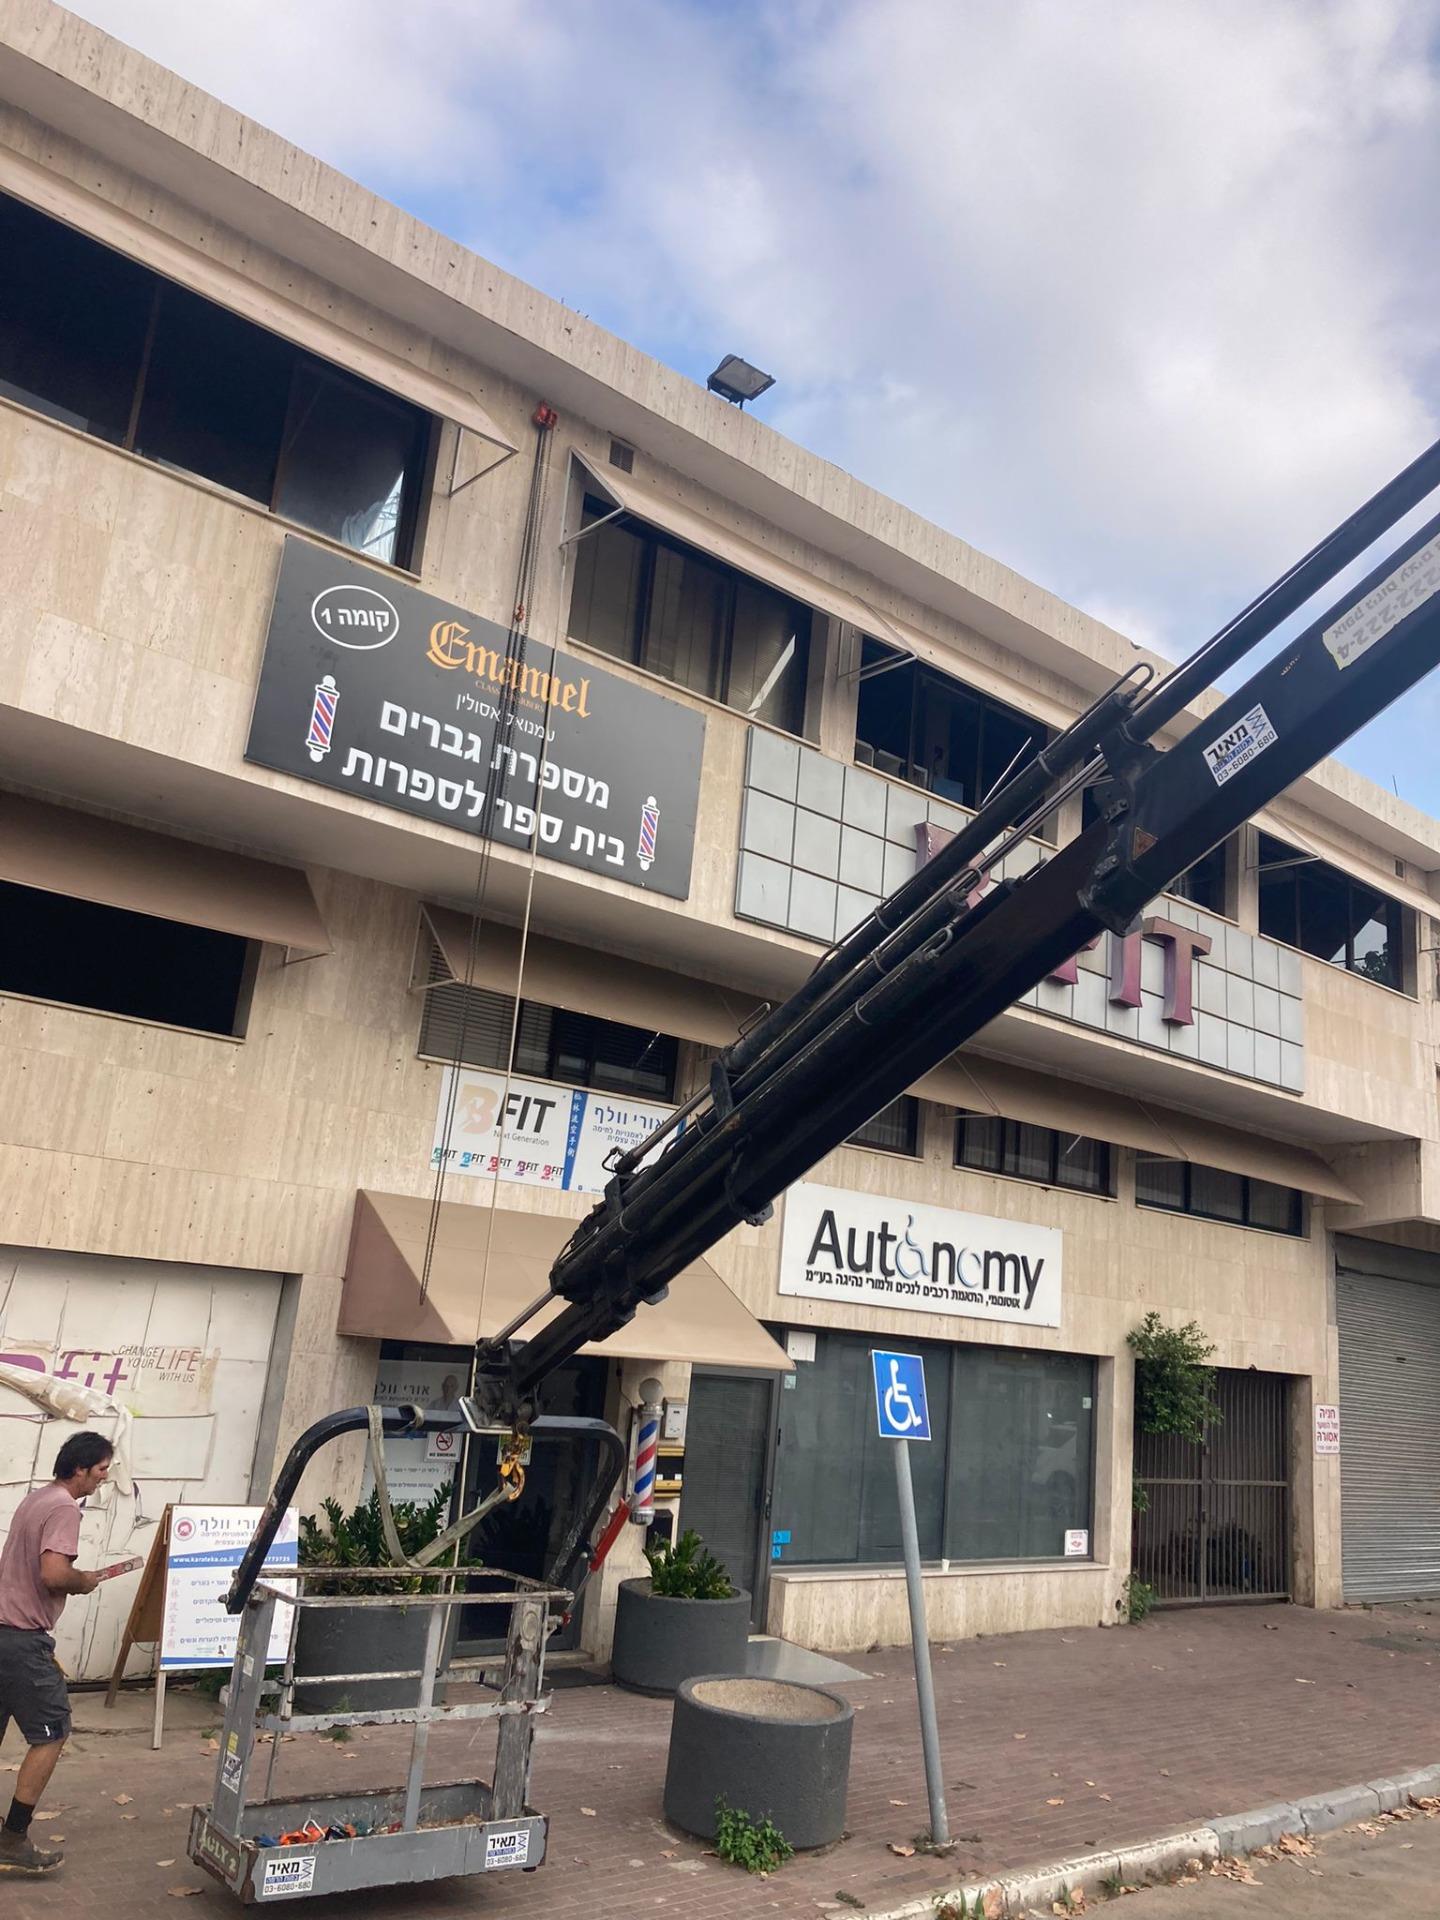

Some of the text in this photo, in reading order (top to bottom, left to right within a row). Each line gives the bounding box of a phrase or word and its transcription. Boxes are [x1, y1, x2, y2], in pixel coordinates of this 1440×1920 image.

[320, 605, 391, 633] קומה 1
[425, 620, 592, 719] Emanuel
[456, 693, 501, 723] אסולין
[1208, 723, 1250, 763] מאיר
[379, 700, 611, 810] מספרת גברים
[1217, 730, 1276, 783] 03-6080-680
[341, 747, 626, 867] בית ספר לספרות
[594, 1105, 628, 1125] וולף
[511, 1133, 550, 1146] Generation
[806, 1208, 1045, 1311] Autonomy
[835, 1273, 864, 1288] נהיגה
[895, 1280, 921, 1297] לנכים
[922, 1285, 950, 1300] רכבים
[118, 1344, 203, 1372] CHANGE LIFE
[127, 1357, 154, 1369] YOUR
[159, 1371, 196, 1384] WITH US
[200, 1516, 256, 1532] ורי וולף
[490, 1835, 516, 1849] מאיר
[269, 1861, 300, 1875] מאיר
